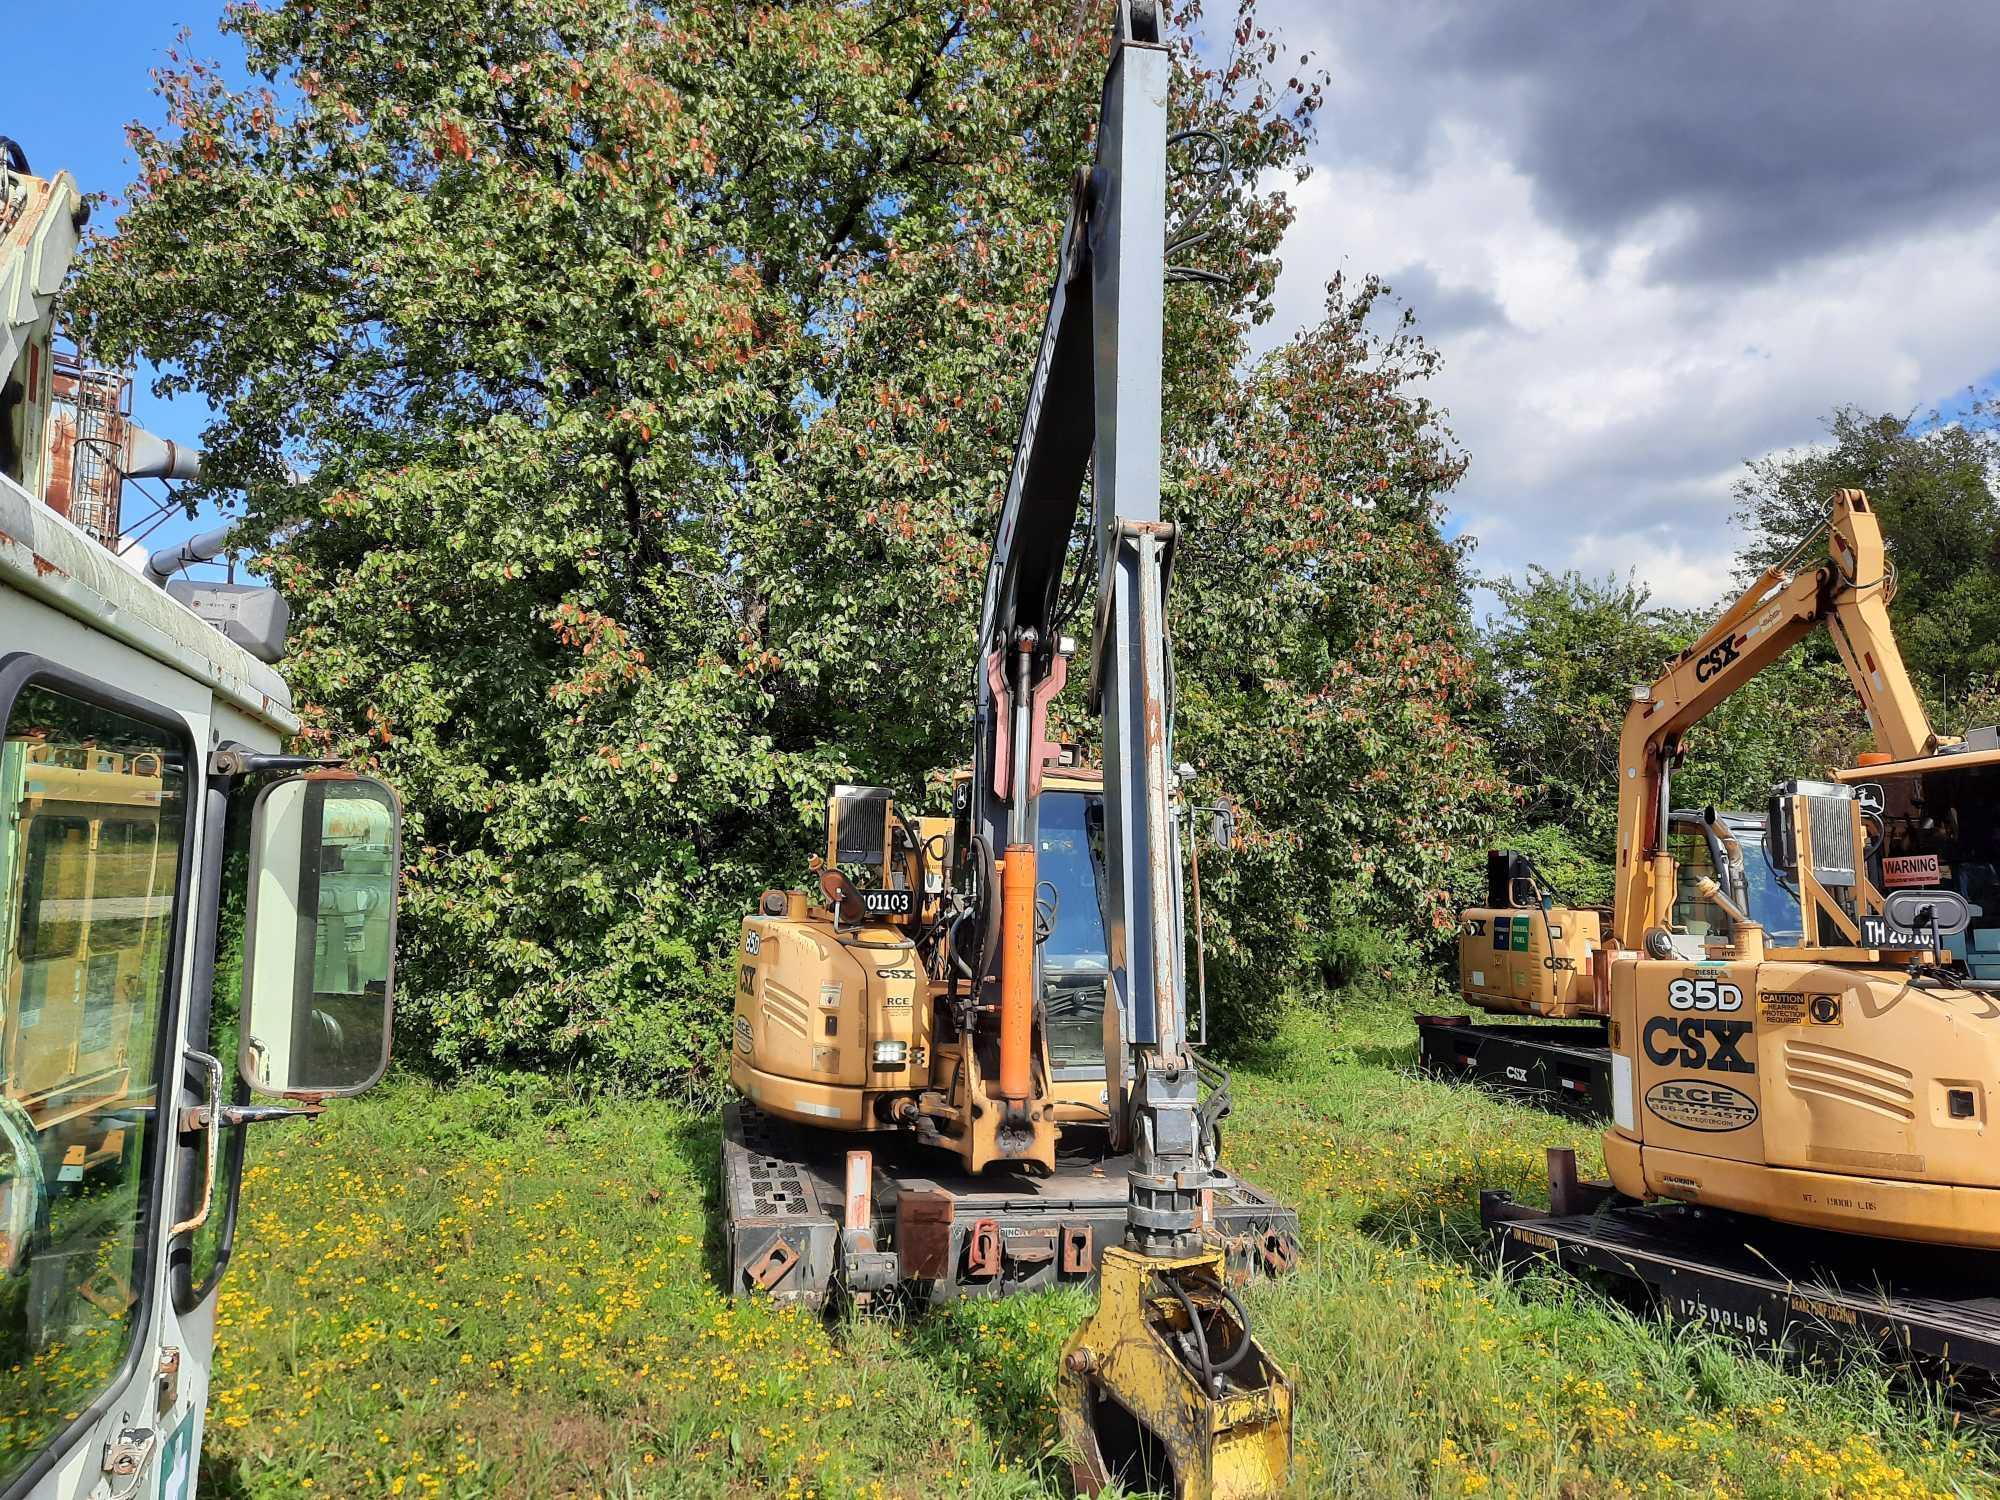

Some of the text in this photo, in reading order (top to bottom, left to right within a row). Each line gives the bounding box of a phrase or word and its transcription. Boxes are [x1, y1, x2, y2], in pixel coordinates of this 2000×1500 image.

[1017, 321, 1056, 494] DEERE
[1695, 632, 1741, 683] CSX
[1884, 857, 1937, 874] WARNING
[863, 893, 909, 910] 01103
[1543, 956, 1576, 970] CSX
[740, 963, 756, 997] CSX
[876, 969, 917, 979] CSX
[886, 997, 910, 1006] RCE
[1668, 977, 1743, 1012] 85D
[1761, 993, 1805, 1004] CAUTION
[1761, 1009, 1806, 1018] PROTECTION
[1767, 1003, 1799, 1011] HEARING
[737, 1020, 750, 1035] RCE
[1766, 1016, 1802, 1025] REQUIRED
[1642, 1015, 1756, 1074] CSX
[1506, 1065, 1527, 1082] CSX
[1662, 1085, 1735, 1106] RCE
